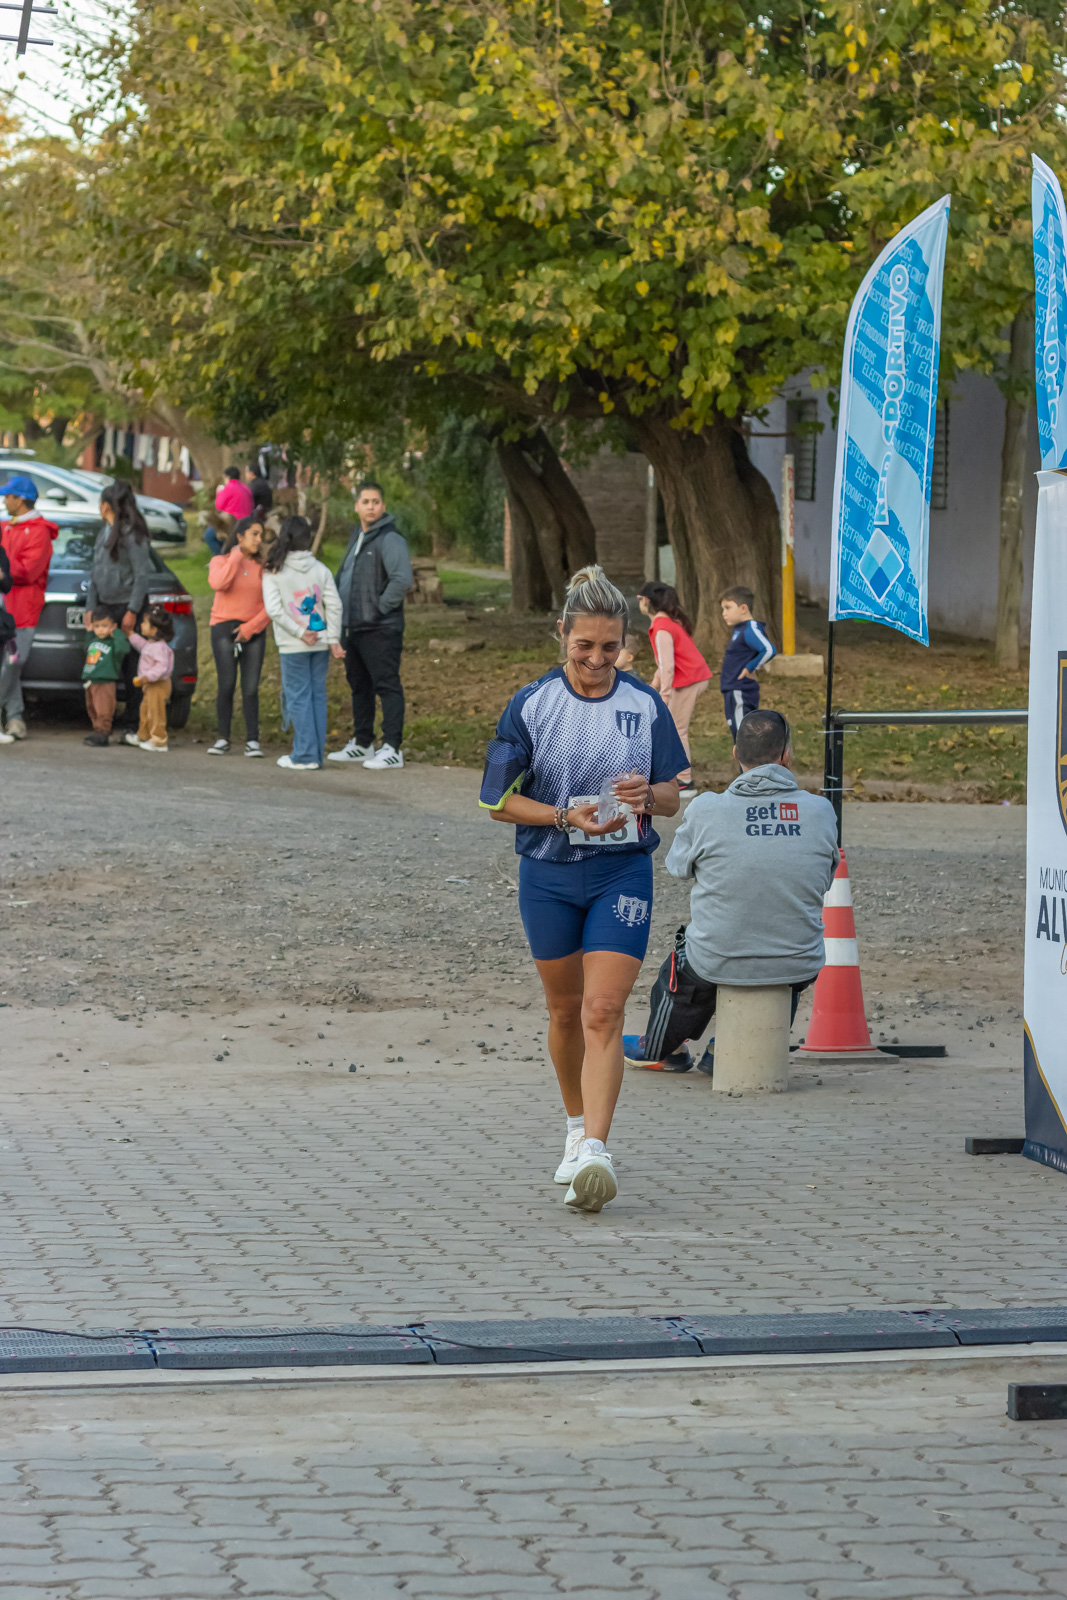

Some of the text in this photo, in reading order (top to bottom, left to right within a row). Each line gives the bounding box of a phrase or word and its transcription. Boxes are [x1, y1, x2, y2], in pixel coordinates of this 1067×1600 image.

[881, 264, 910, 446] SPORTIVO
[620, 712, 637, 721] SFC
[746, 802, 797, 822] get in
[745, 823, 801, 836] GEAR
